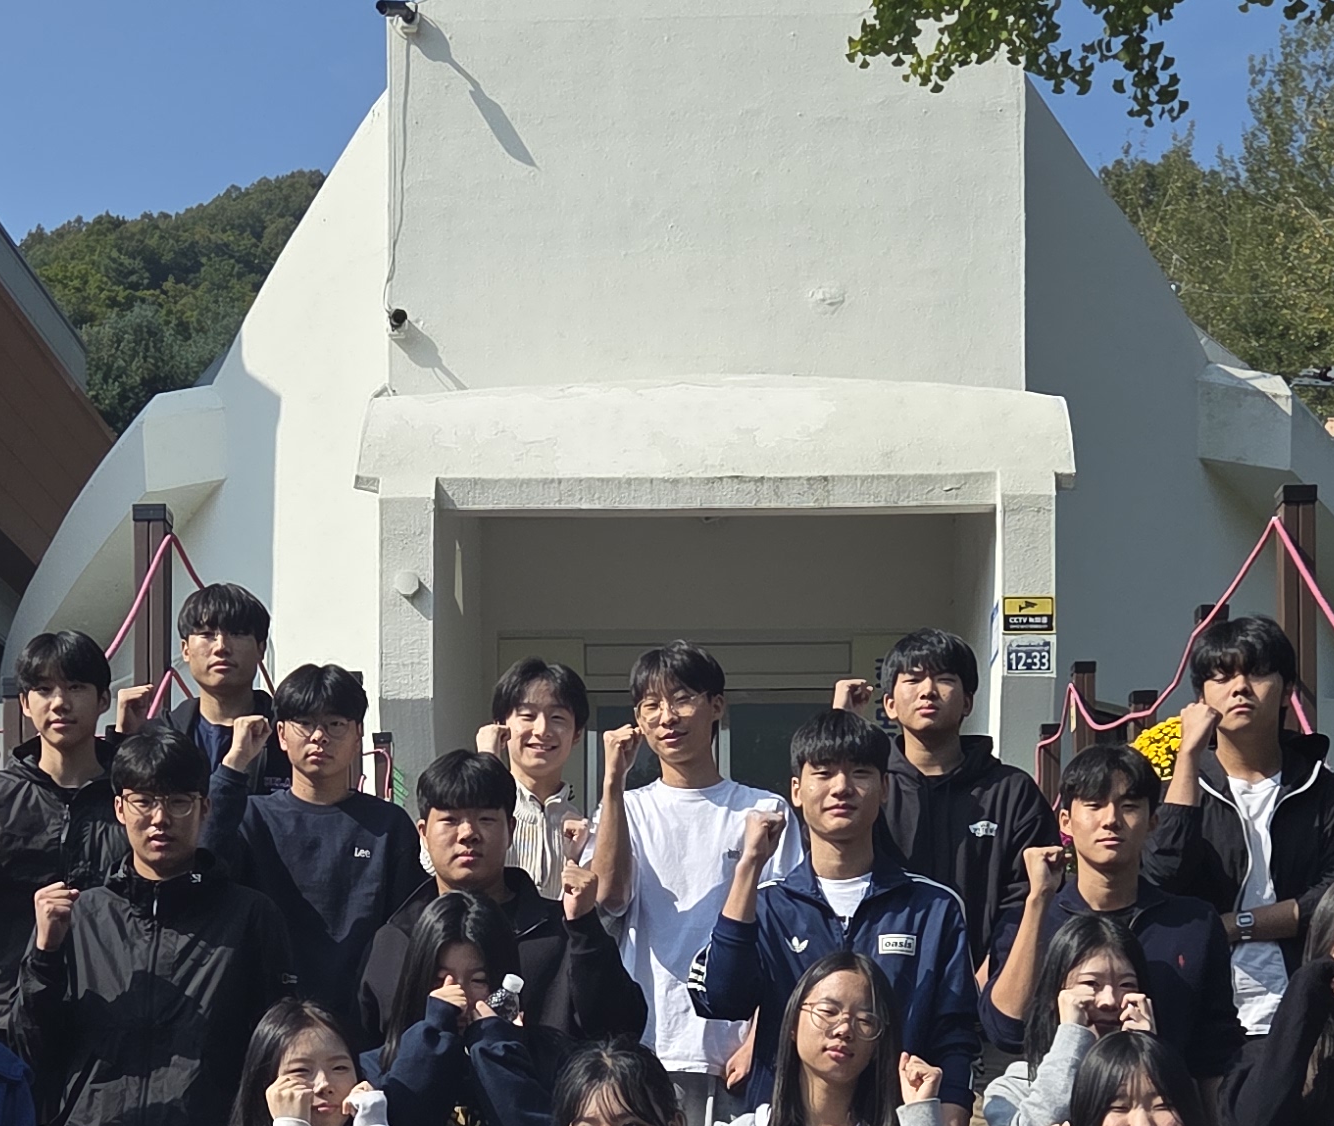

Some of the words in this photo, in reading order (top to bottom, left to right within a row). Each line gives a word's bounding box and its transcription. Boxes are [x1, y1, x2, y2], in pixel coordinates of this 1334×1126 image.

[1008, 616, 1027, 624] CCTV
[1009, 651, 1049, 670] 12-33
[354, 847, 371, 858] Lee
[885, 940, 912, 948] oasis
